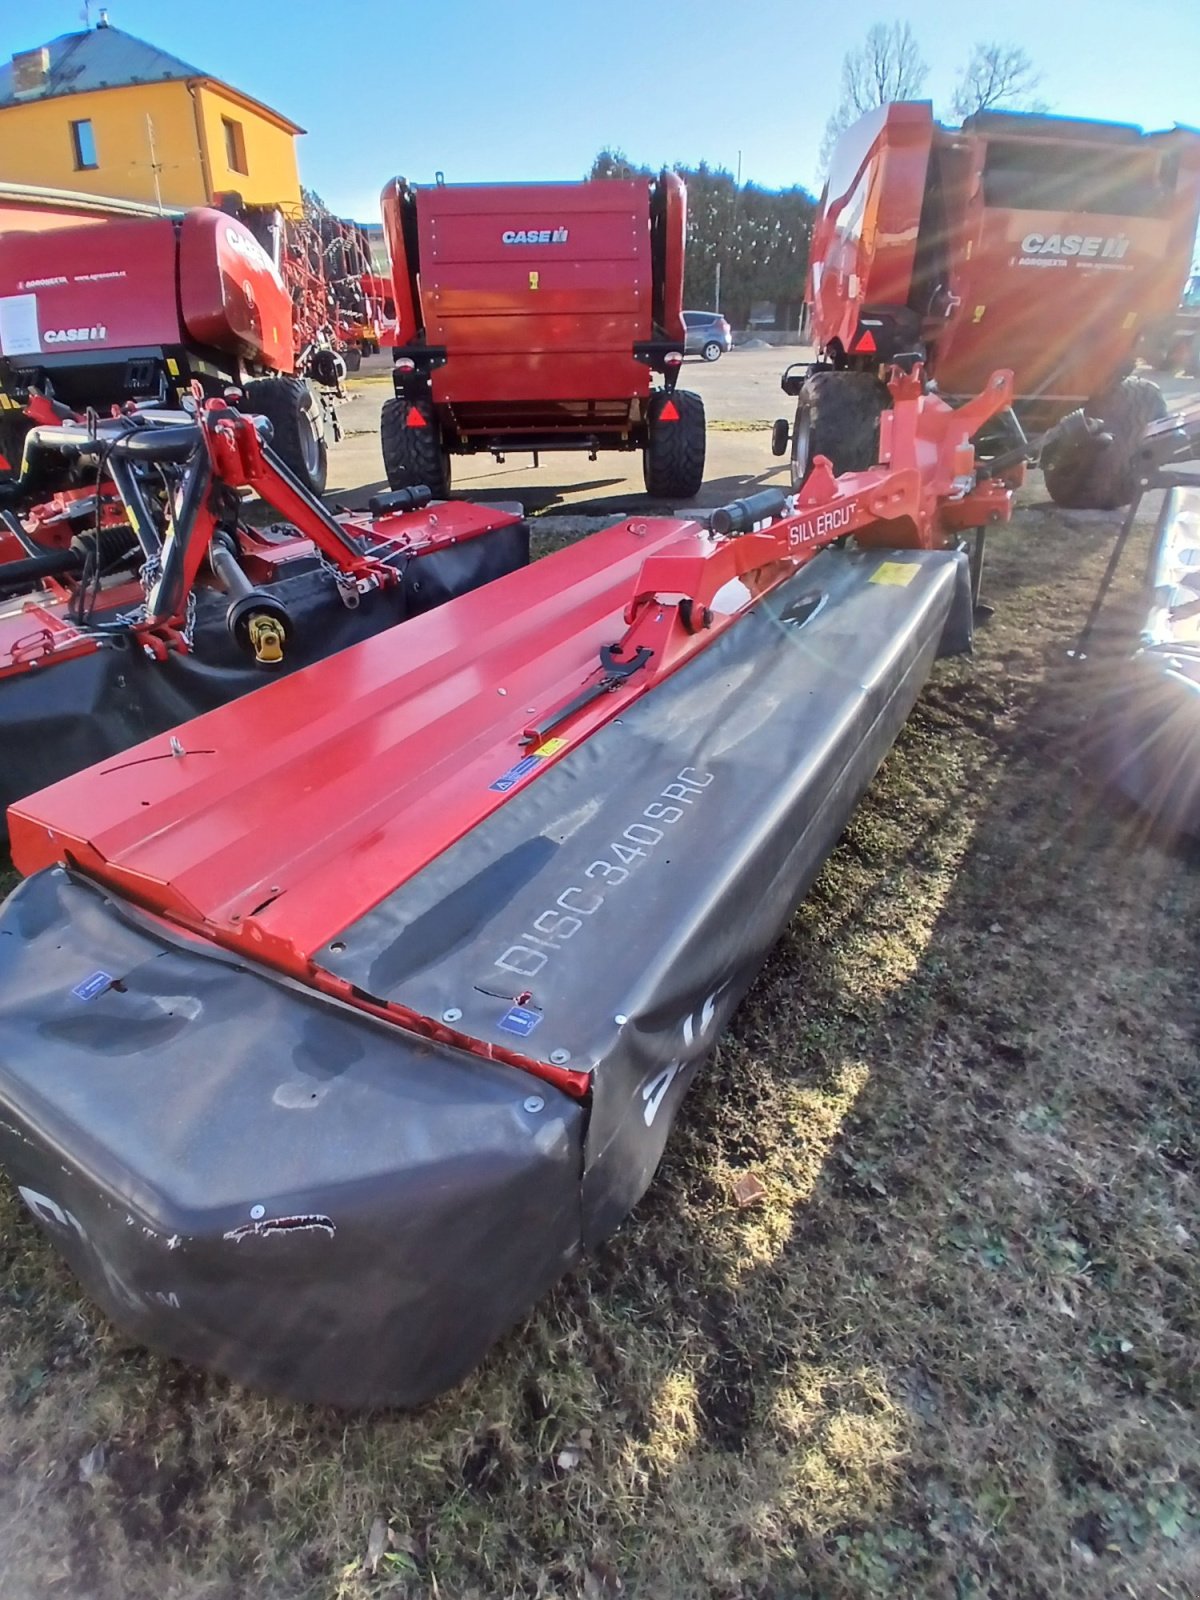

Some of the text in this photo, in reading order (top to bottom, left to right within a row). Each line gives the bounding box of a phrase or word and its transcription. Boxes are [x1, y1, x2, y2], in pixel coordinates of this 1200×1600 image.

[502, 230, 551, 244] CASE
[1021, 233, 1102, 256] CASE
[44, 328, 90, 343] CASE
[494, 887, 604, 977] DISC
